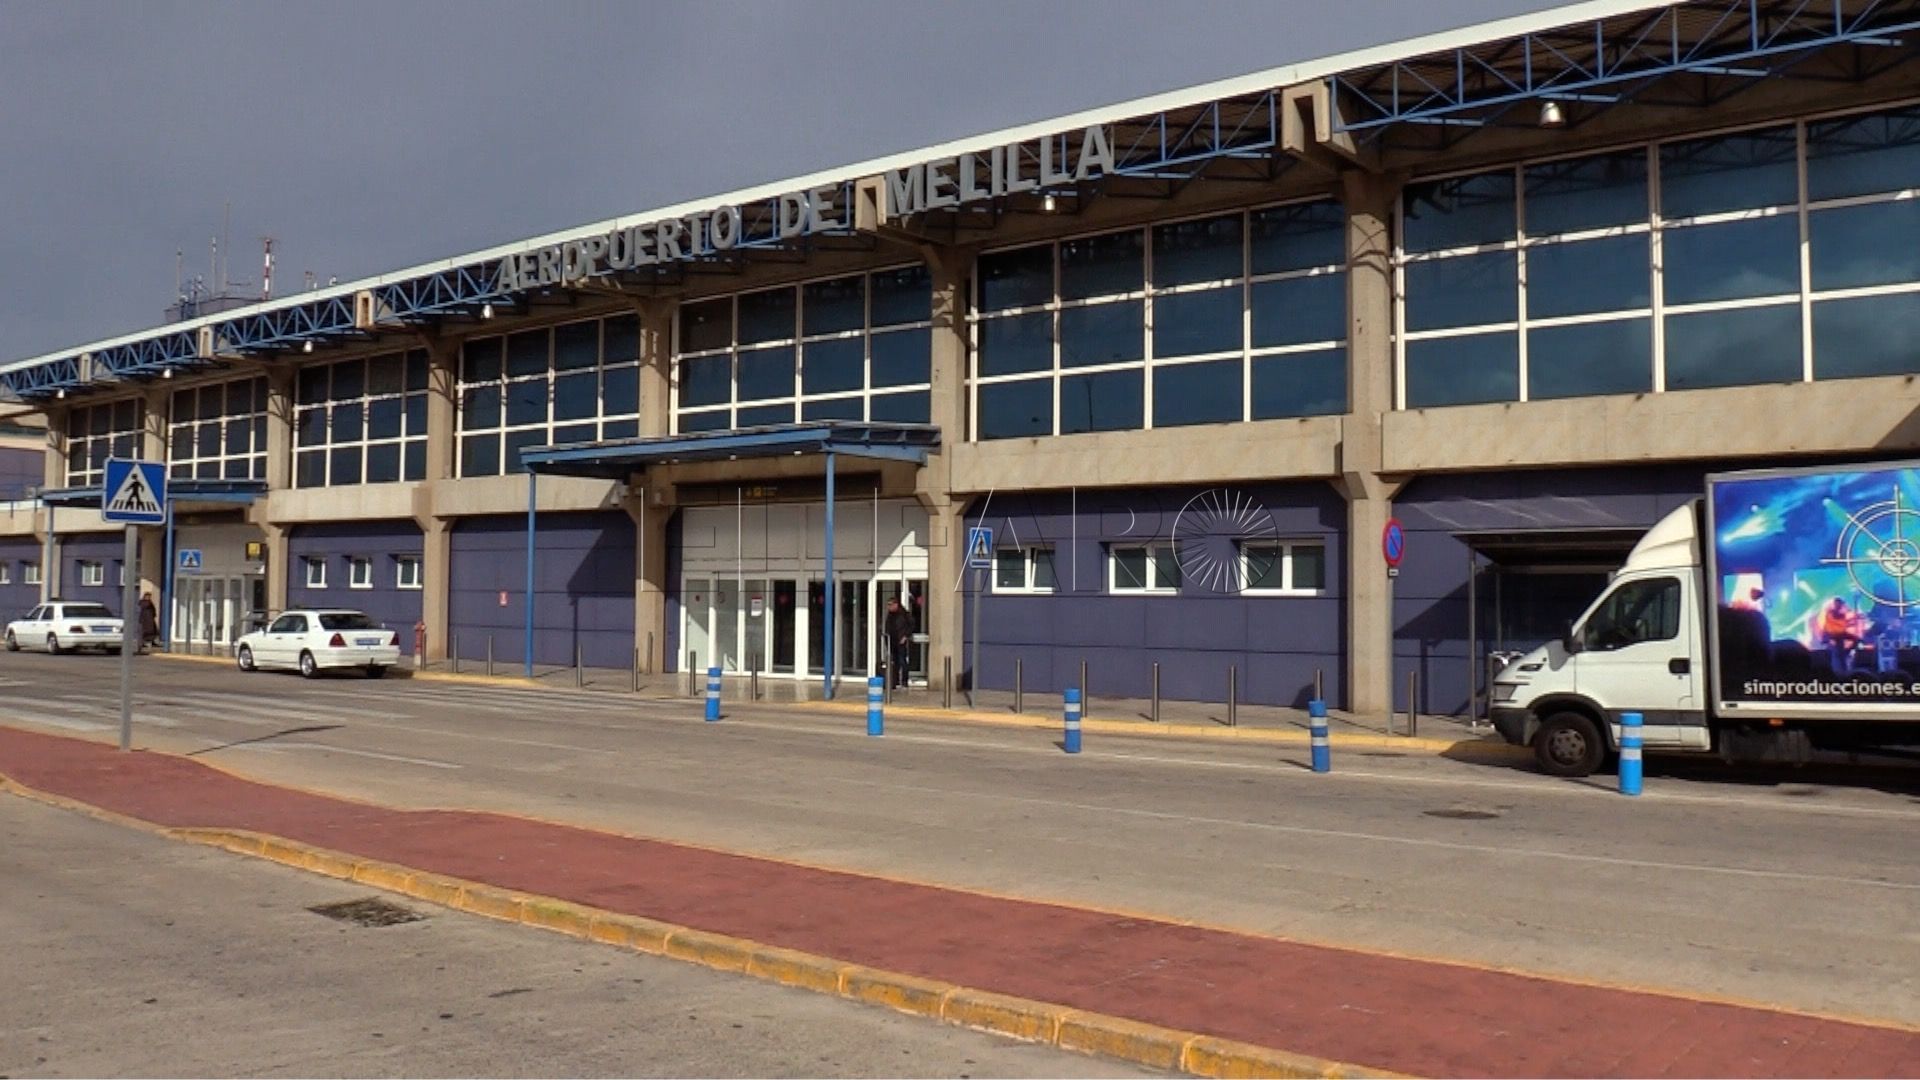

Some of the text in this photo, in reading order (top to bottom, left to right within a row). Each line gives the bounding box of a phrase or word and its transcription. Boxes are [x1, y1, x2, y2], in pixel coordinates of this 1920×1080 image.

[497, 125, 1115, 292] AEROPUERTO DE MELILLA
[1744, 678, 1920, 698] simproducciones.e
